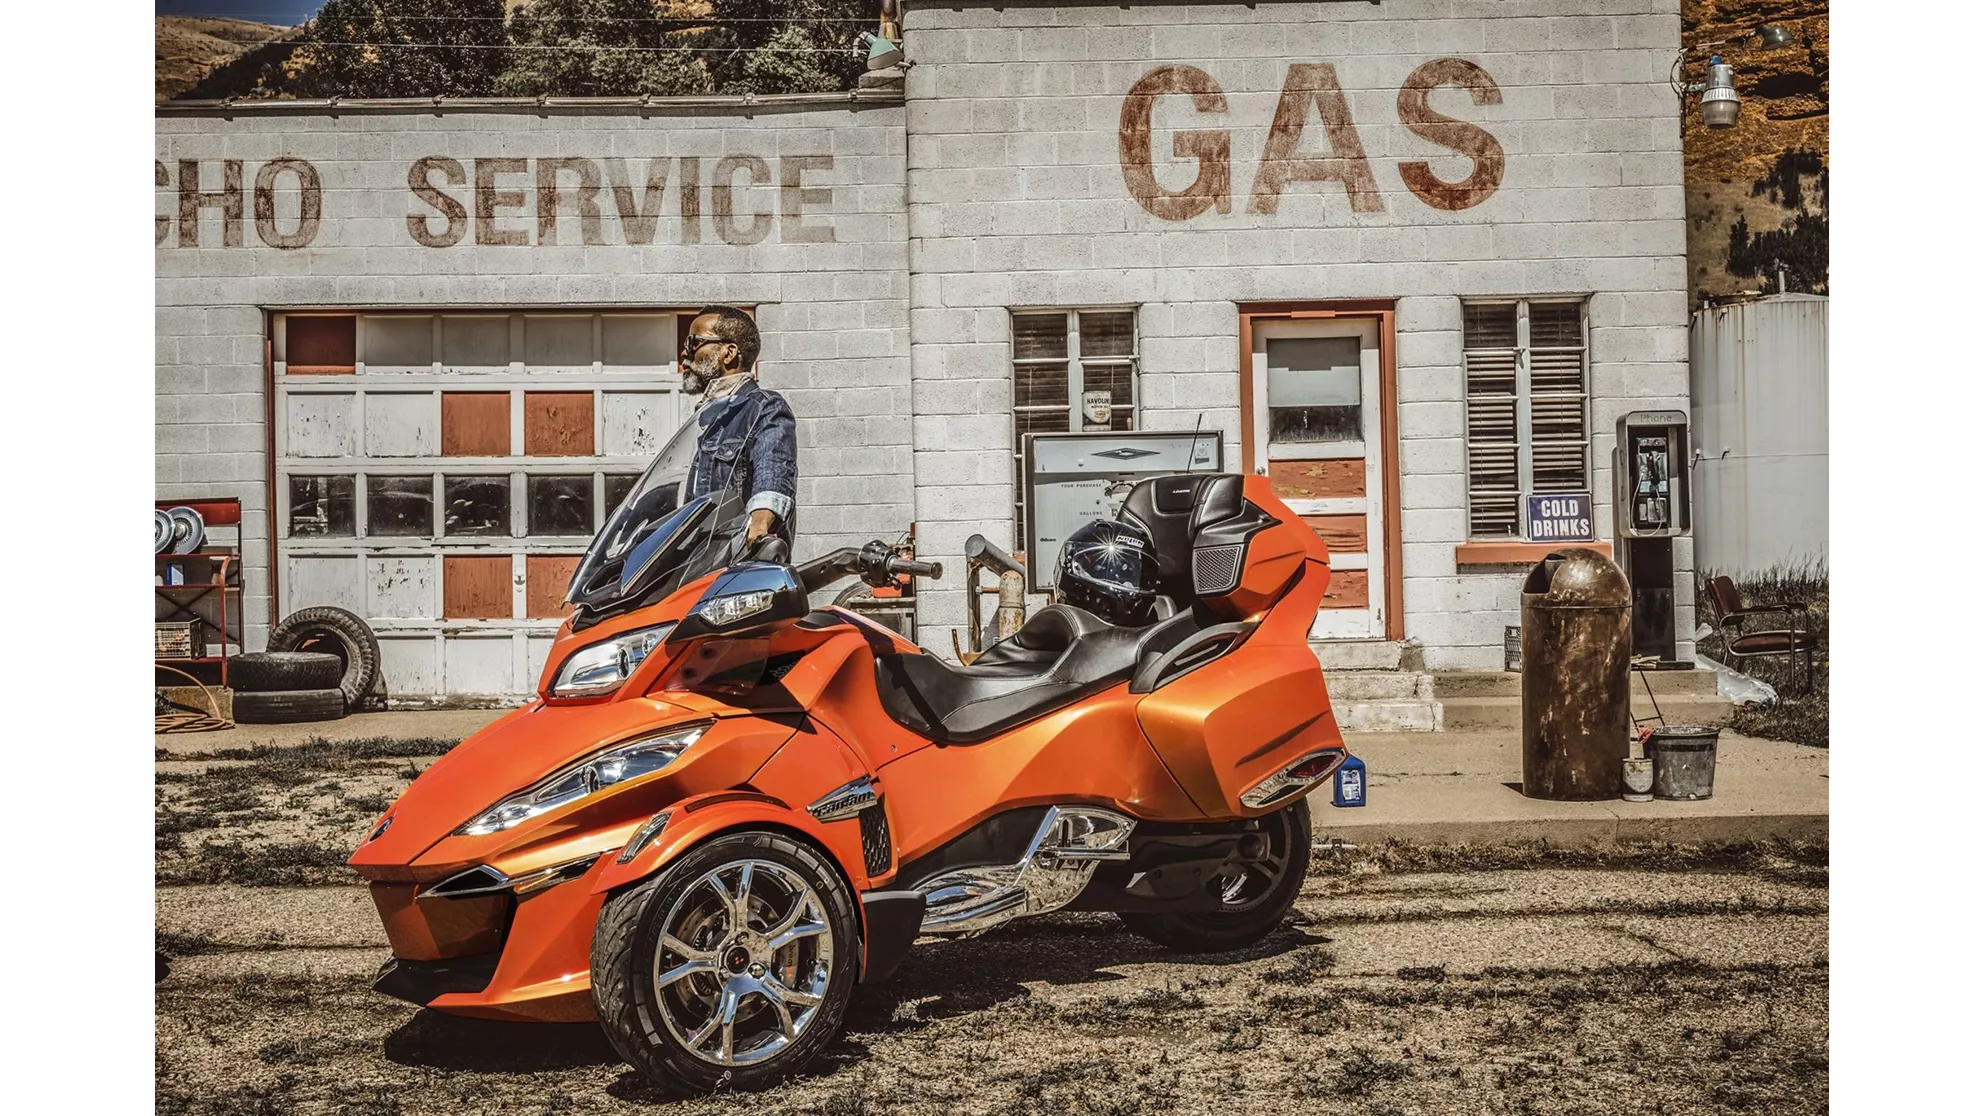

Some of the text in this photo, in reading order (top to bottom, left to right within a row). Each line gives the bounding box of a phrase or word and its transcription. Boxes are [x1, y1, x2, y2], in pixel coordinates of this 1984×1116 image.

[1117, 57, 1506, 222] GAS
[154, 153, 837, 250] HO SERVICE
[1640, 413, 1673, 423] Phone
[1541, 499, 1579, 518] COLD
[1532, 518, 1590, 537] DRINKS
